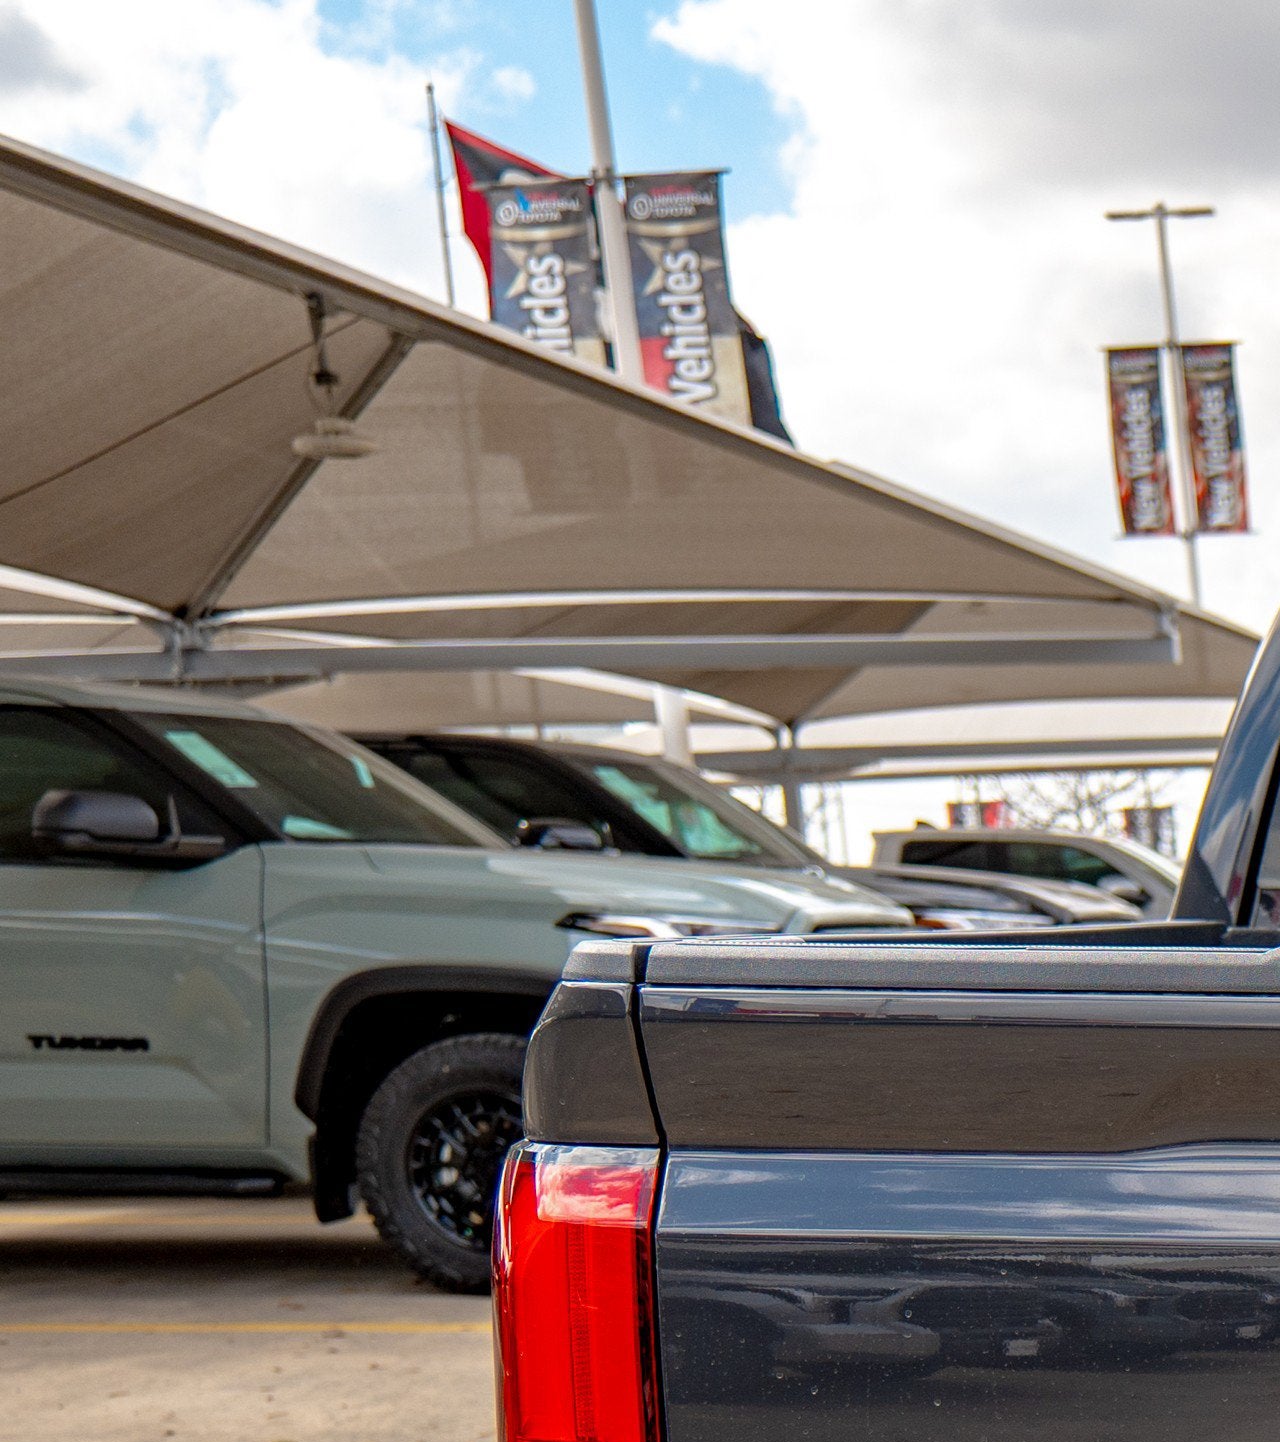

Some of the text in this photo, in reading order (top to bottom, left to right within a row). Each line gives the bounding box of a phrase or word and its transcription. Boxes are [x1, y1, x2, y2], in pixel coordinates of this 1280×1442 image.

[659, 250, 718, 404] Vehicles
[1120, 386, 1154, 479] Vehicles
[1195, 384, 1230, 478] Vehicles
